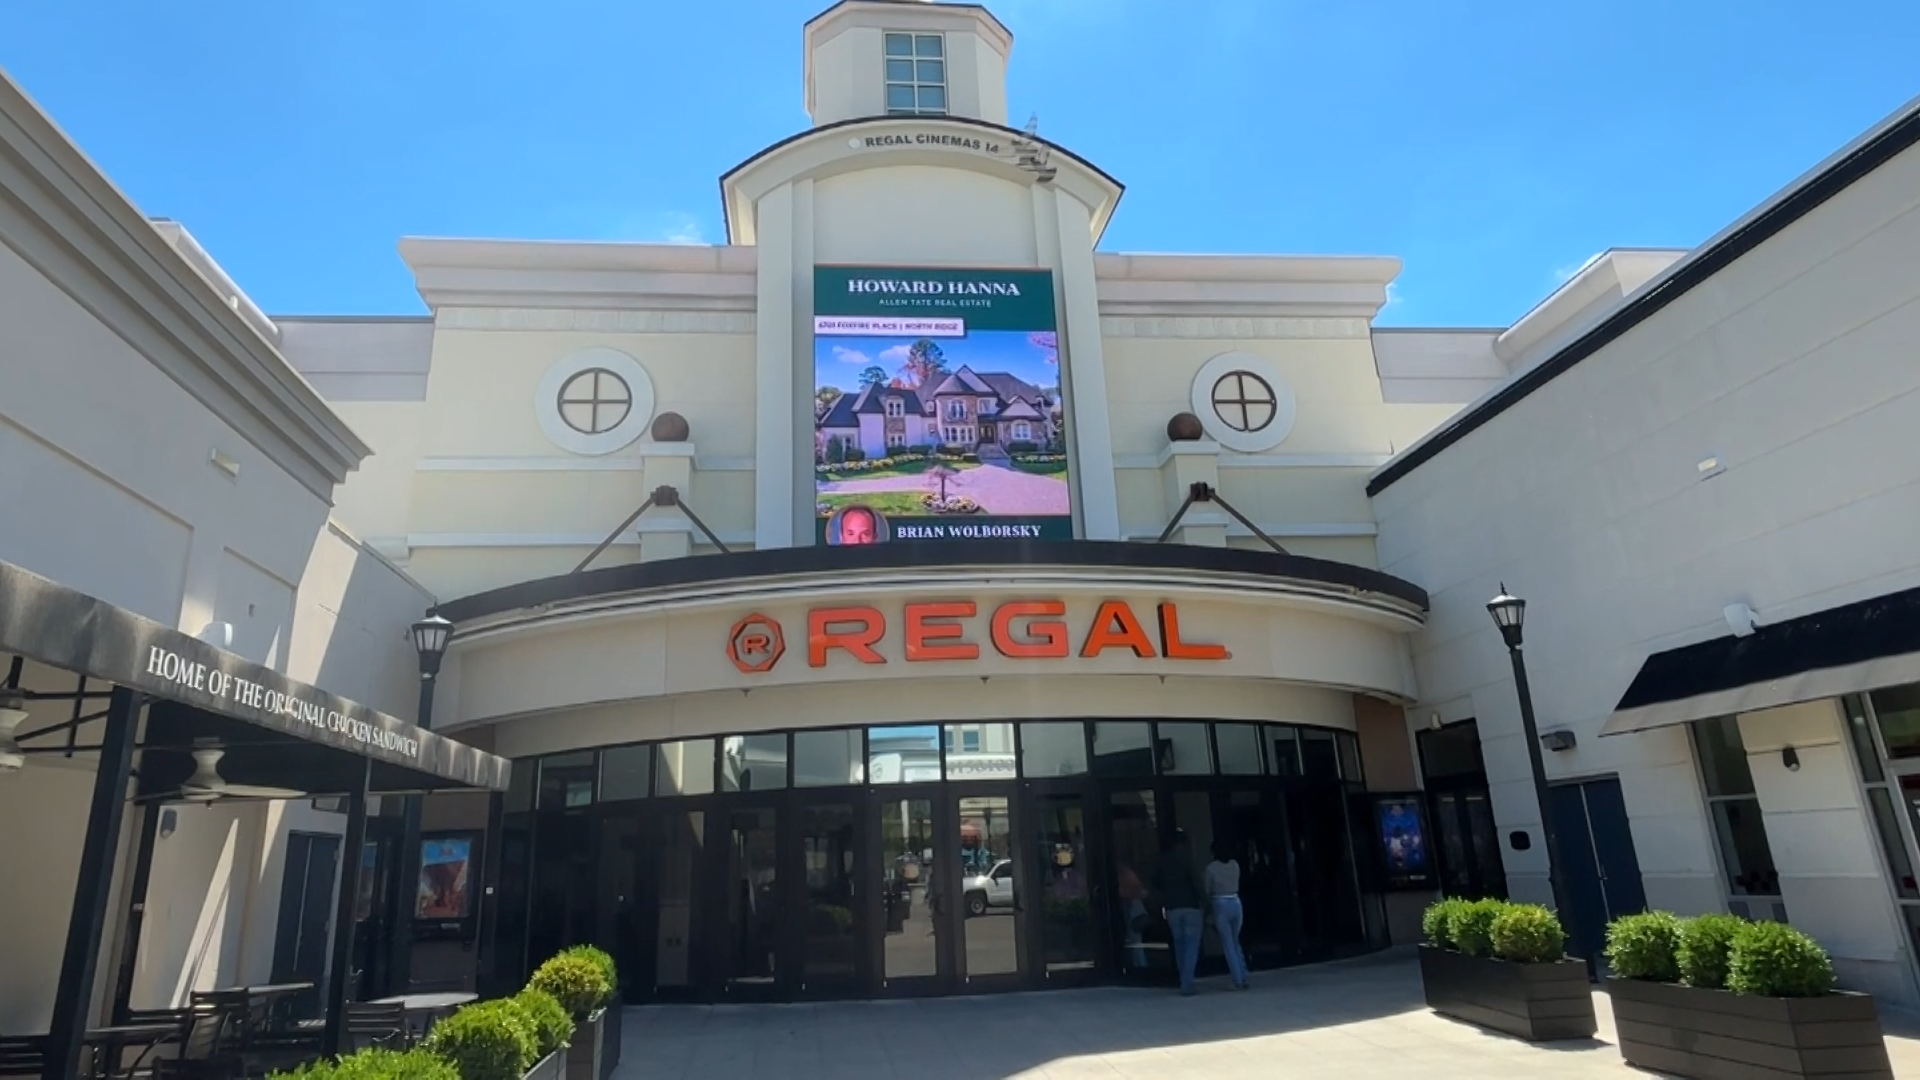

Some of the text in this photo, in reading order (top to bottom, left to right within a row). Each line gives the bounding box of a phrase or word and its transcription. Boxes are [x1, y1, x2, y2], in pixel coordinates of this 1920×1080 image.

[865, 133, 999, 154] REGAL CINEMAS 14
[848, 279, 1021, 297] HOWARD HANNA
[879, 299, 991, 308] ALLEN TATE REAL ESTATE
[897, 525, 1042, 539] BRIAN WOLBORSKY
[806, 600, 1227, 668] REGAL
[146, 645, 418, 759] HOME OF THE ORIGINAL CHICKEN SANDWICH
